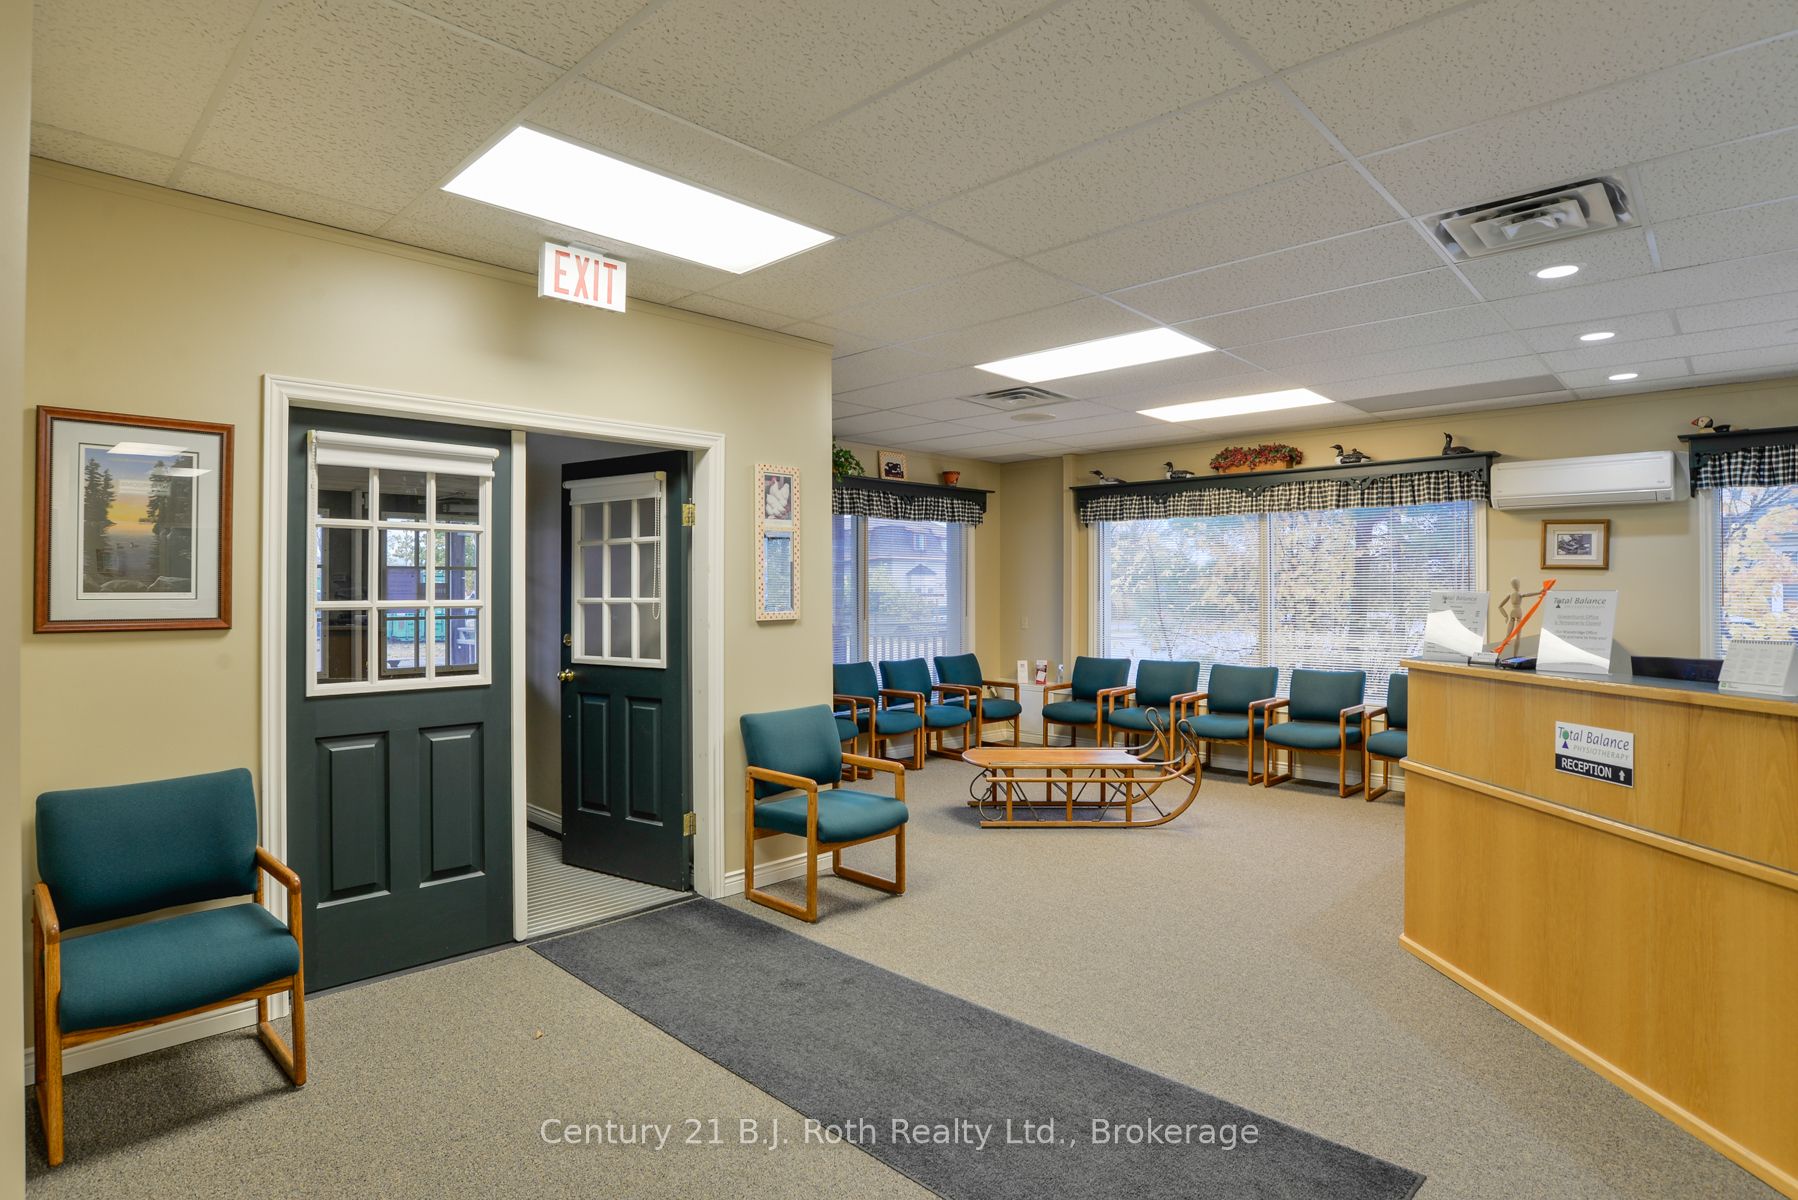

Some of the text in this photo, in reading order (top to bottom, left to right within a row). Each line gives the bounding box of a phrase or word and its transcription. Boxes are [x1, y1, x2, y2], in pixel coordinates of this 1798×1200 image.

[554, 250, 617, 304] EXIT
[1574, 597, 1607, 605] Balance
[1558, 726, 1630, 751] Total Balance
[1573, 745, 1630, 761] PHYSIOTHERAPY
[1561, 758, 1612, 779] RECEPTION
